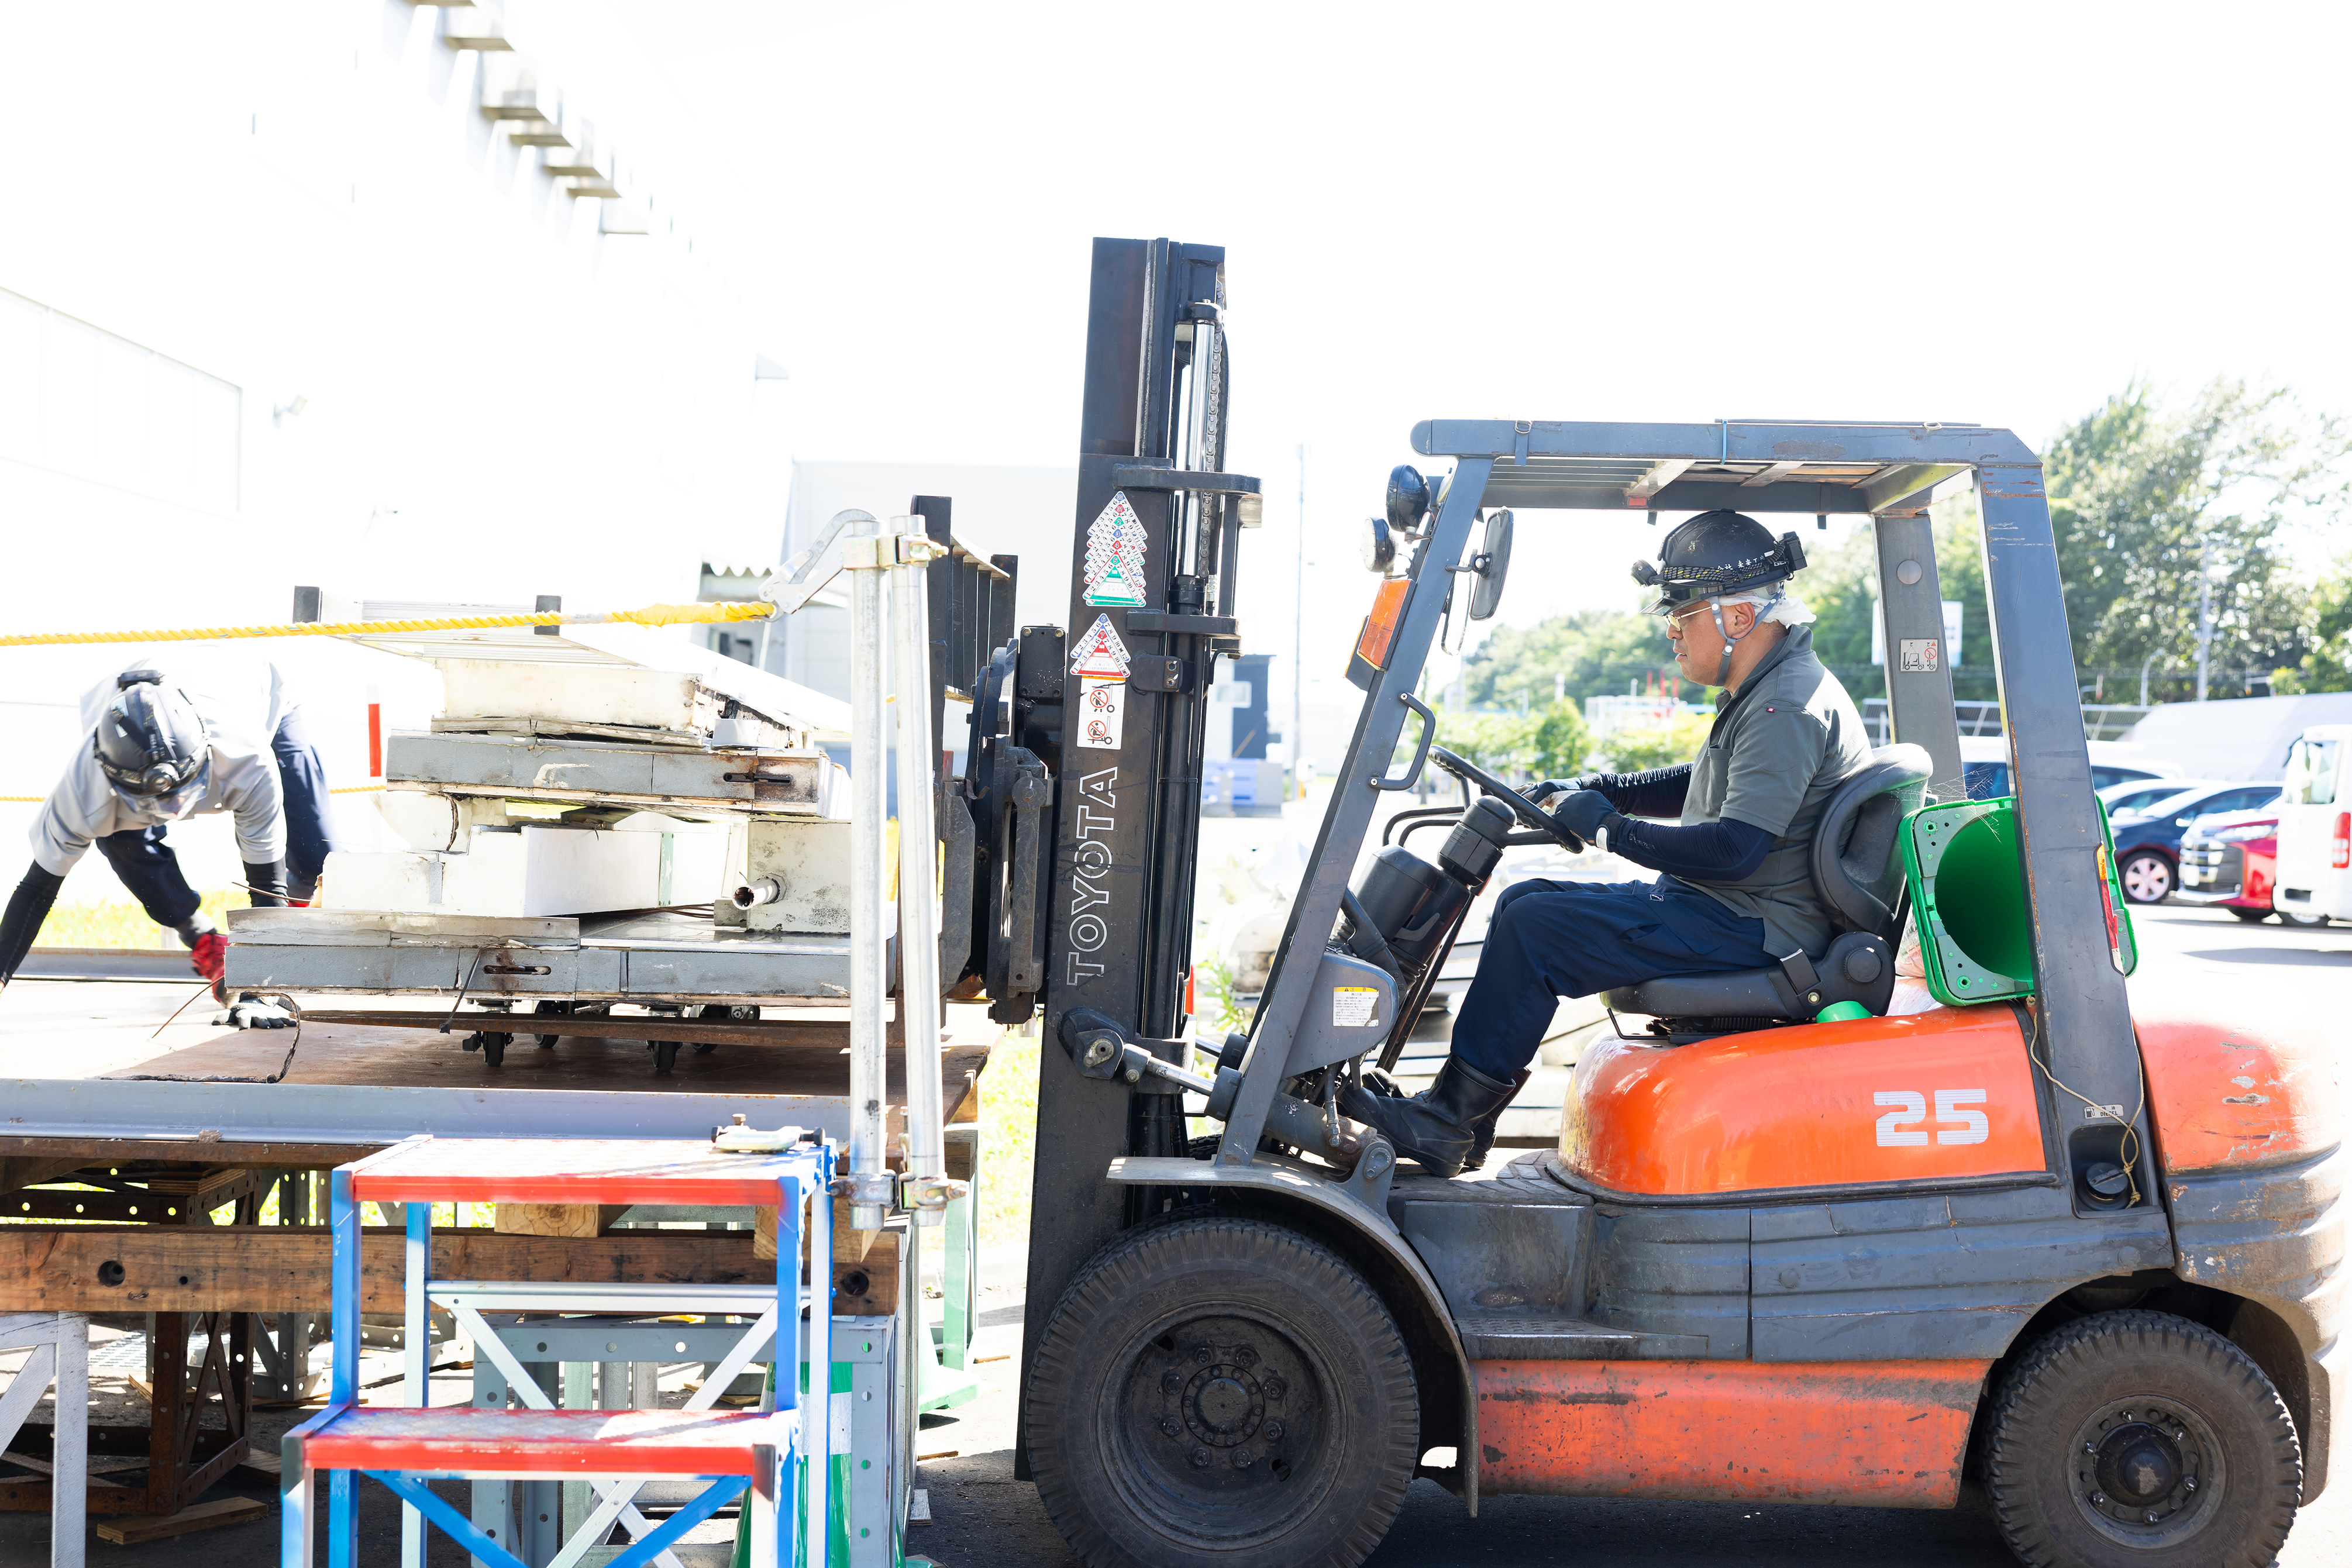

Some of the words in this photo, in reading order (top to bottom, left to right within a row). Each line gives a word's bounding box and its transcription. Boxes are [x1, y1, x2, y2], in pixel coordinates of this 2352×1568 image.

[1066, 766, 1118, 985] TOYOTA
[1874, 1088, 1989, 1146] 25
[1303, 1304, 1369, 1394] BRIDGESTONE
